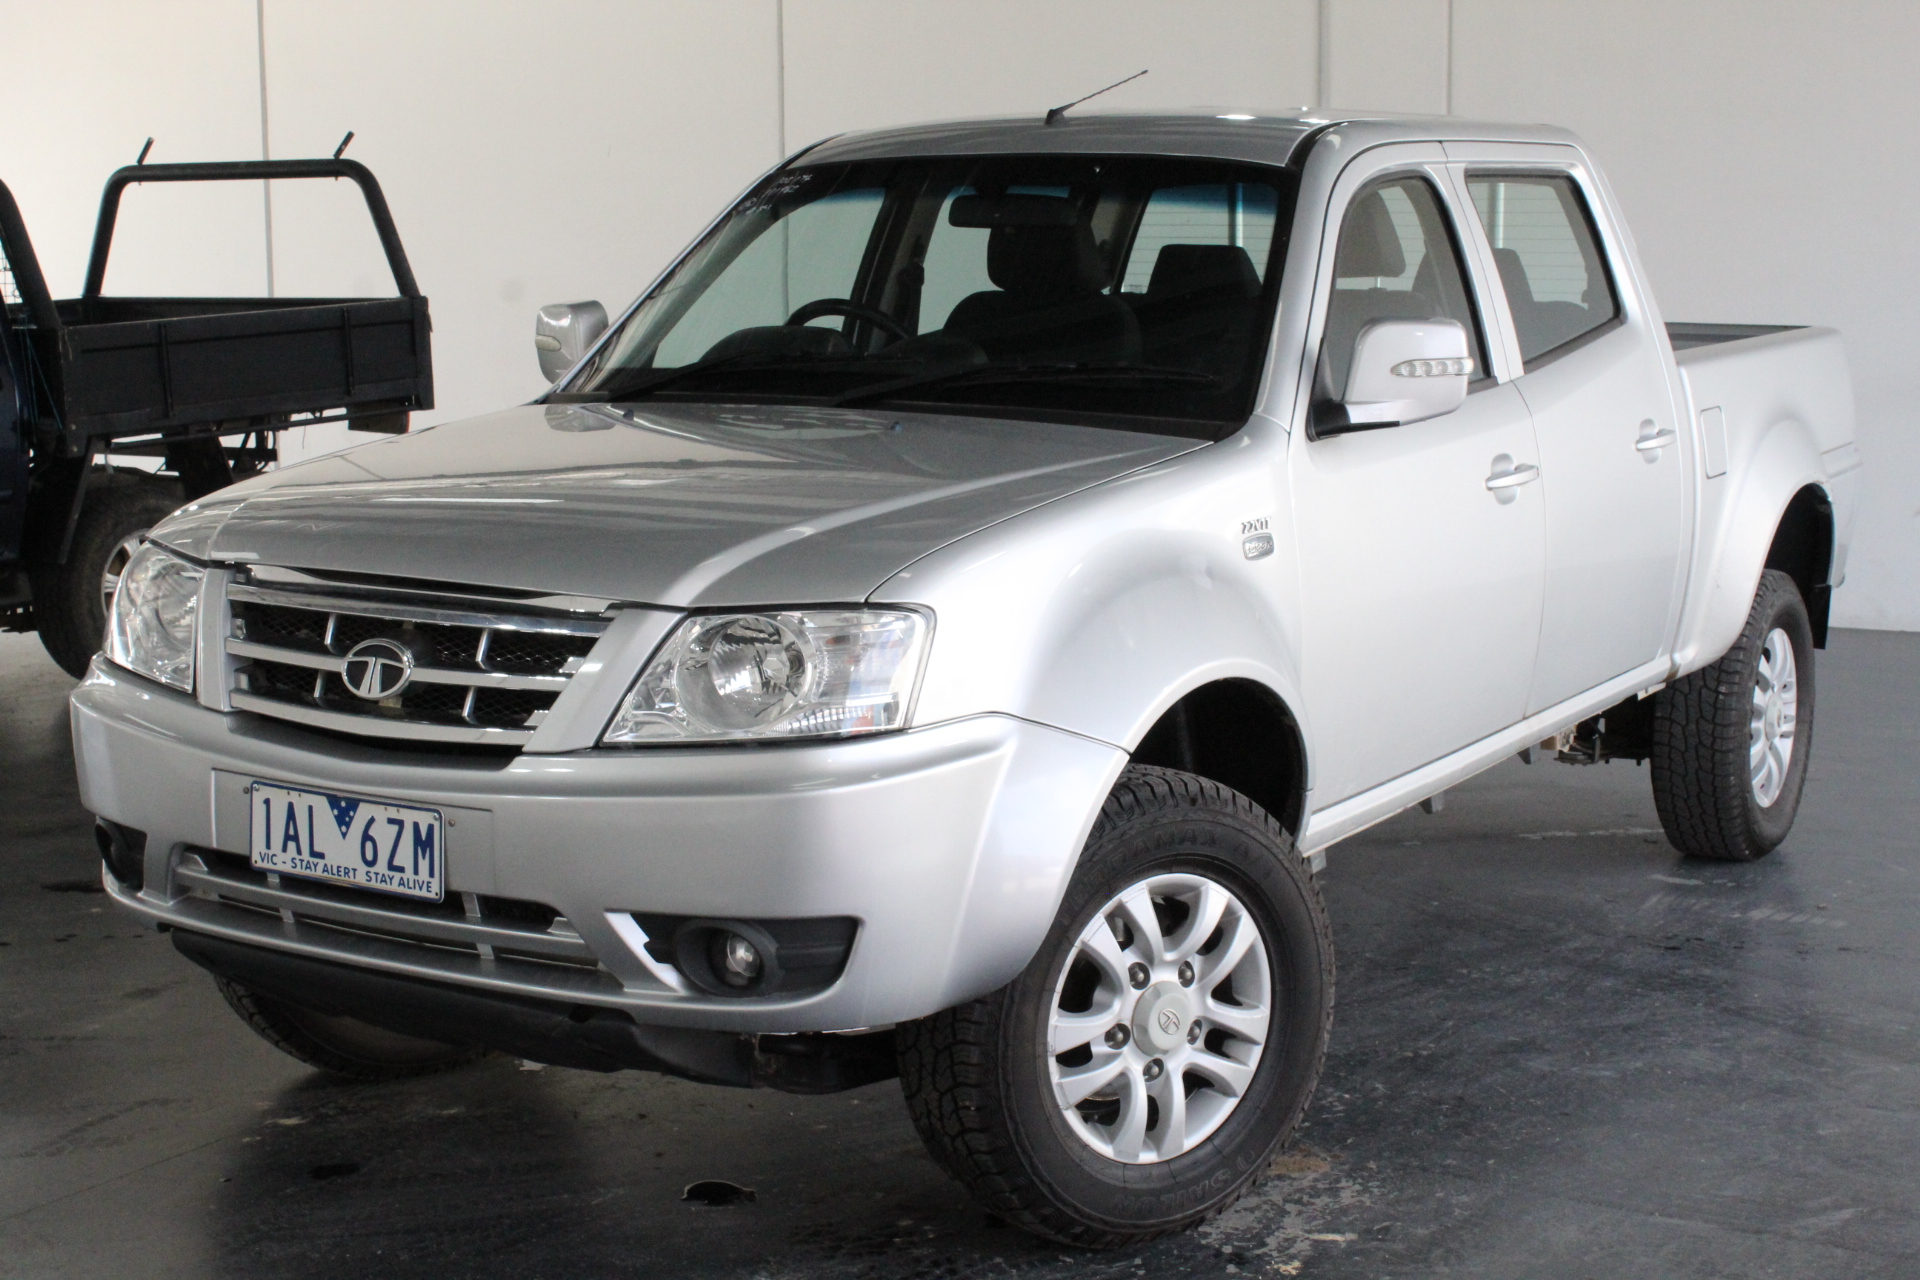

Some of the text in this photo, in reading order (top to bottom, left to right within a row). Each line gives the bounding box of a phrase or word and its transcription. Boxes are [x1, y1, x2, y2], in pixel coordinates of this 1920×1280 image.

[263, 797, 435, 879] 1AL 6ZM
[259, 851, 277, 866] VIC
[291, 857, 319, 875] STAY
[322, 862, 358, 880] ALERT
[365, 870, 395, 886] STAY
[397, 878, 432, 893] ALIVE
